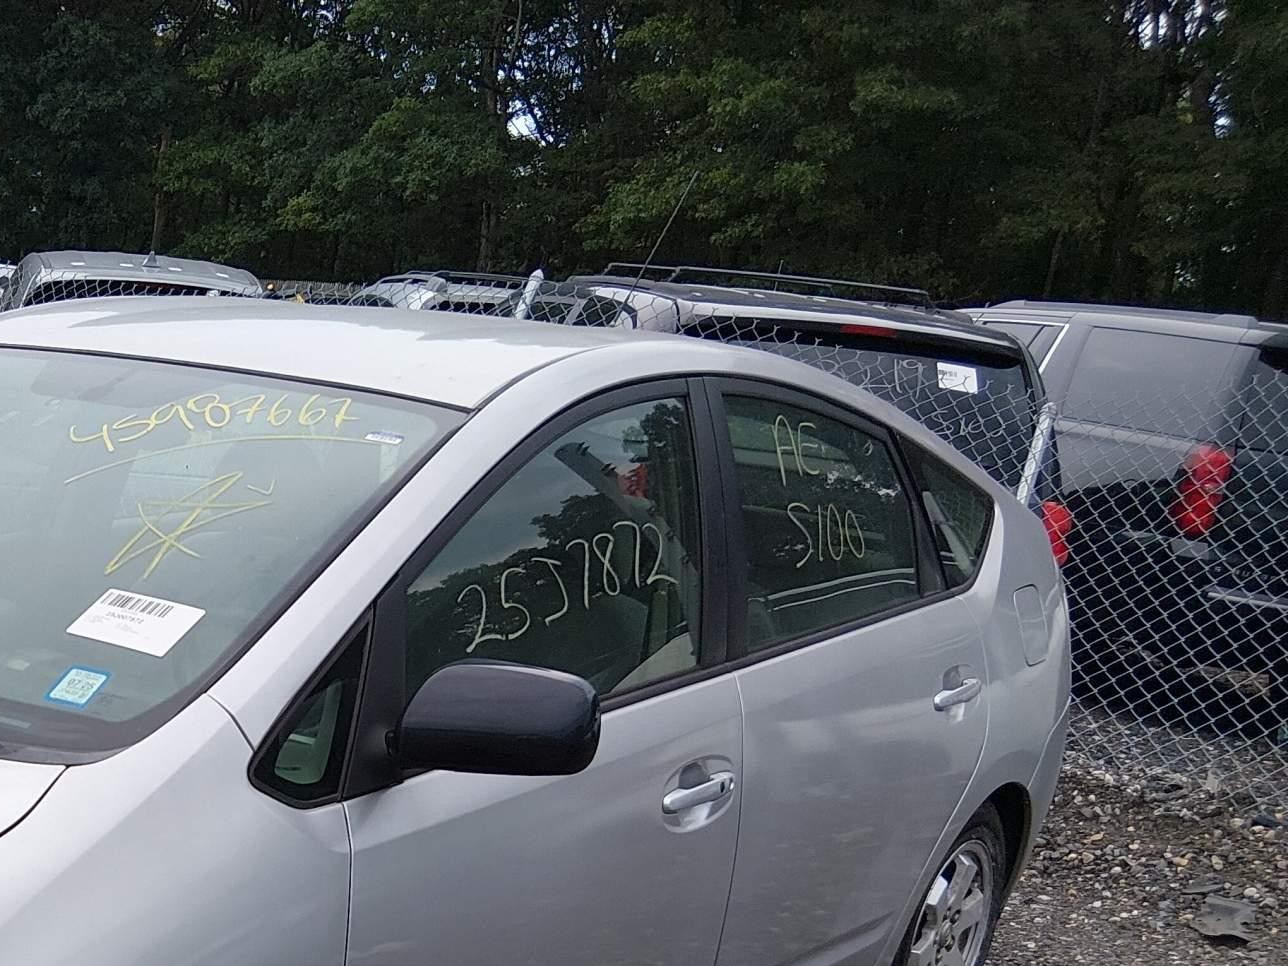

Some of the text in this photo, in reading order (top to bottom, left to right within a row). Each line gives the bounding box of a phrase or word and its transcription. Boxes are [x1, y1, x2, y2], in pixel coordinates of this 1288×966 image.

[70, 394, 360, 452] 45987667
[787, 502, 865, 568] S100
[457, 521, 679, 652] 25J7872
